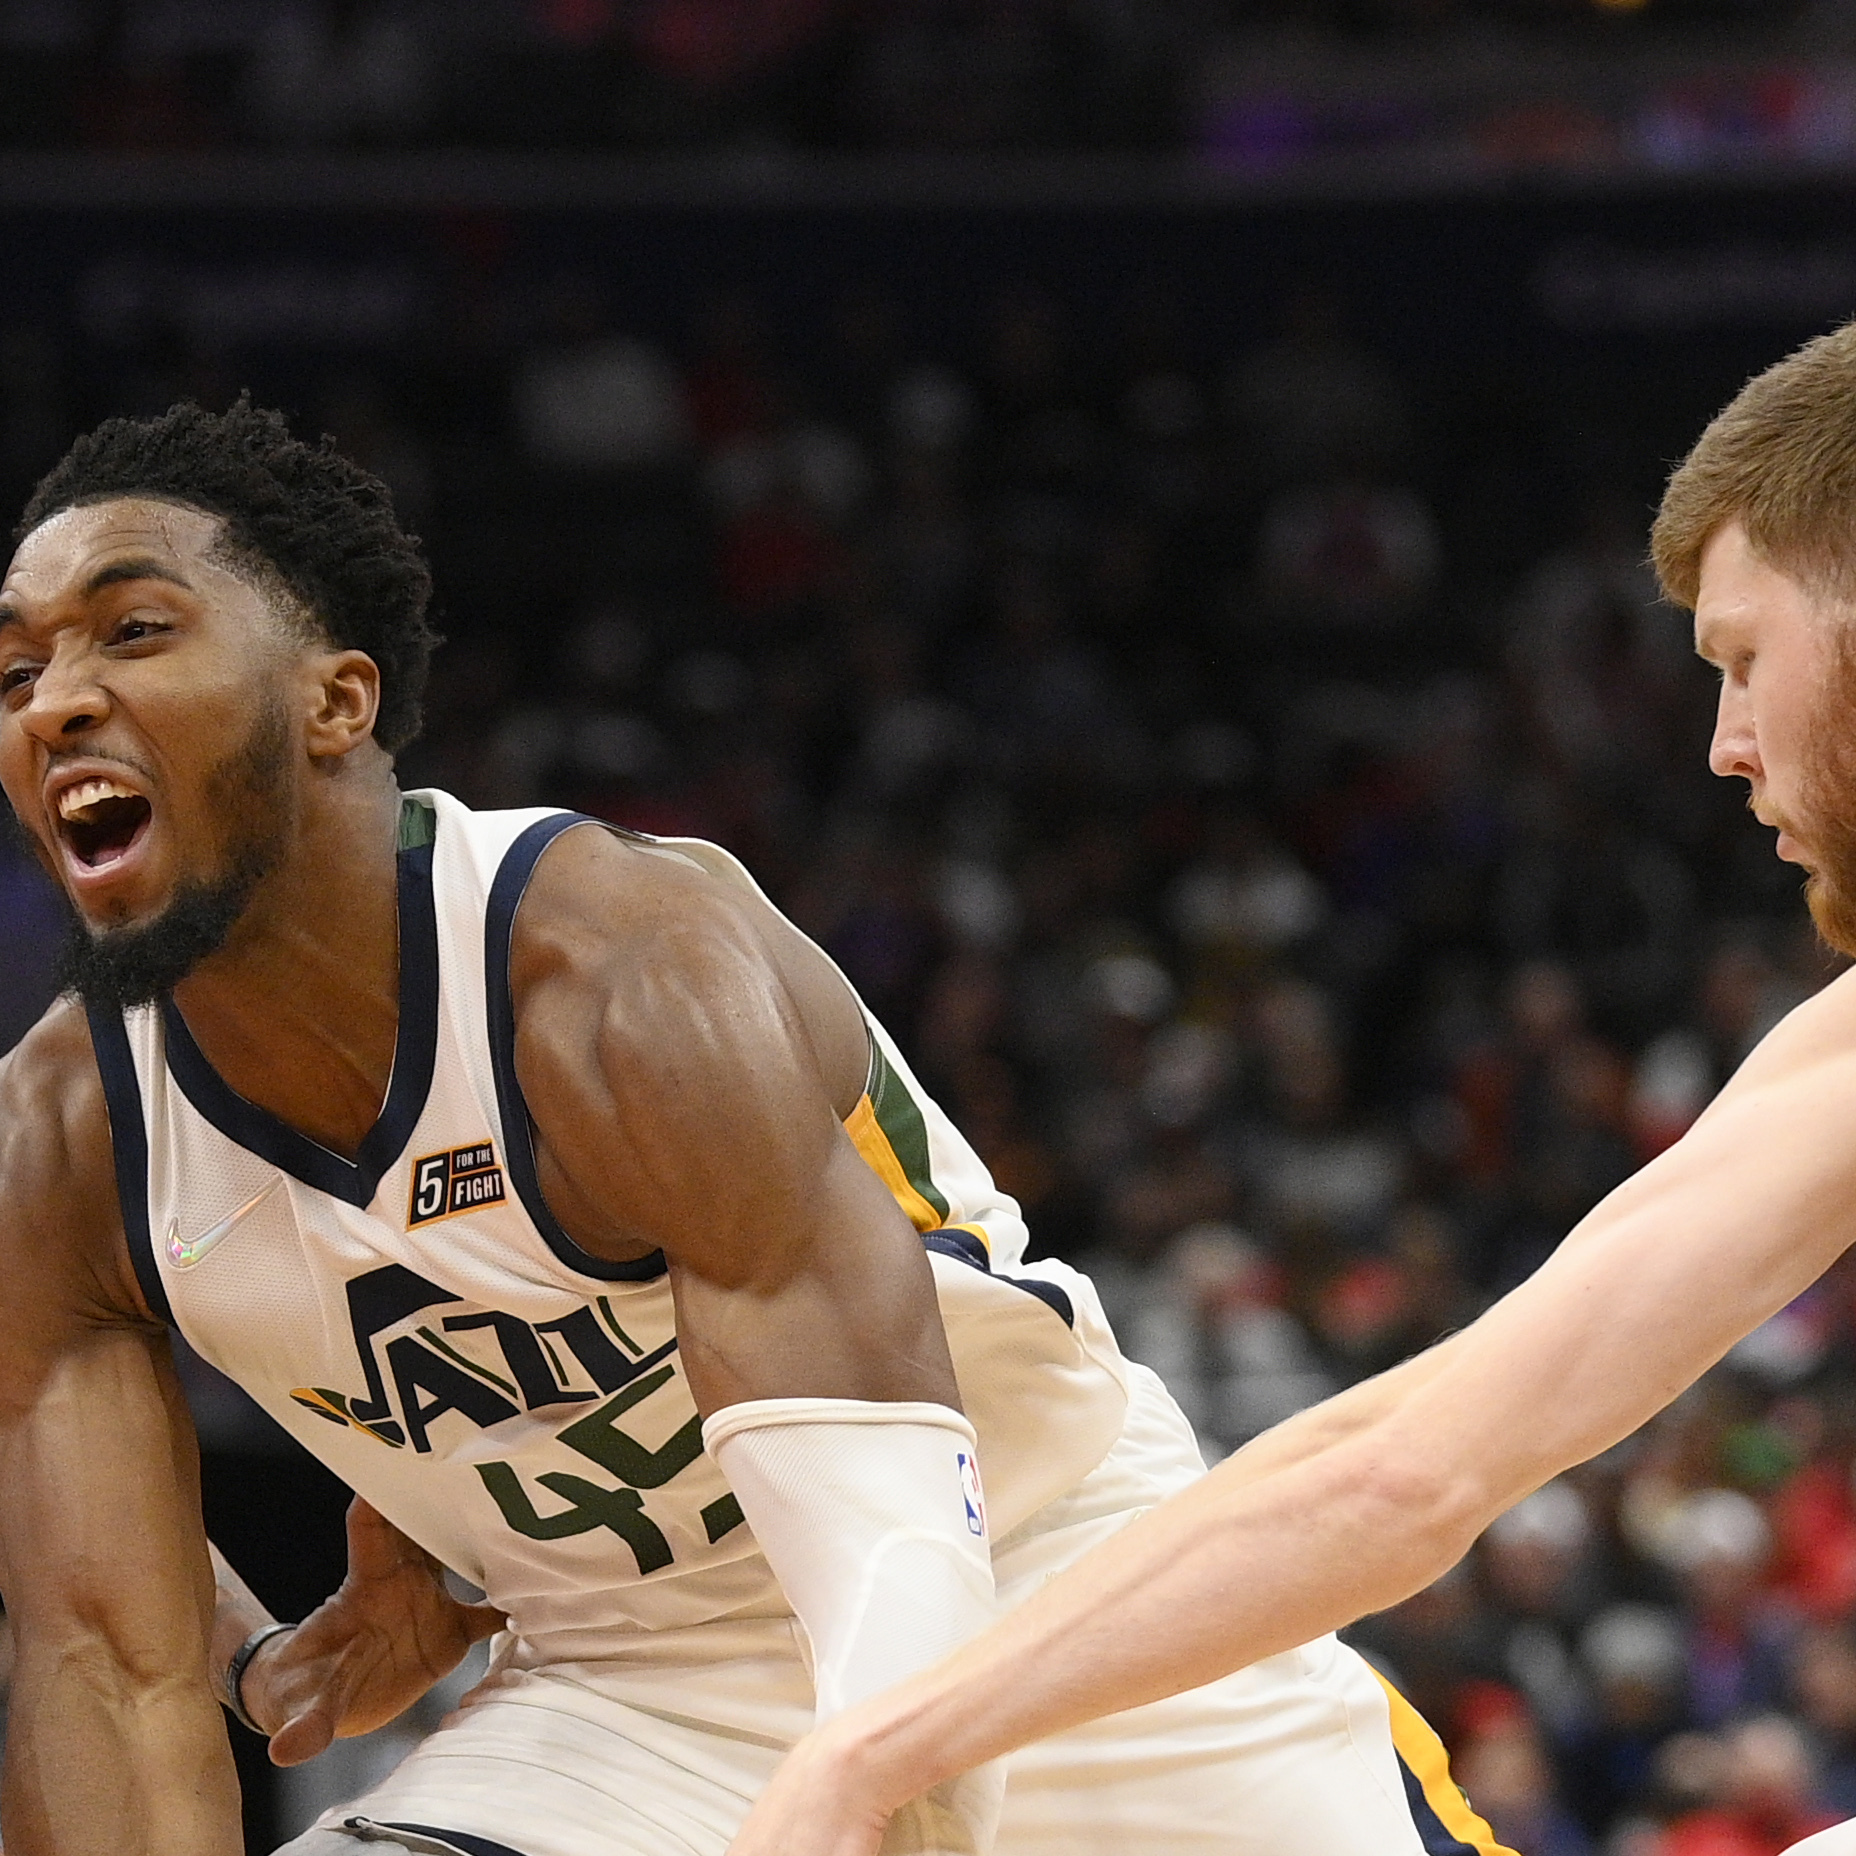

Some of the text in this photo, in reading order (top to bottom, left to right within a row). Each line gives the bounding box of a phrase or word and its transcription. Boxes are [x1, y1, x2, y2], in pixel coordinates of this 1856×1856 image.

[456, 1147, 492, 1169] FOR THE
[417, 1159, 444, 1216] 5
[454, 1173, 501, 1205] FIGHT
